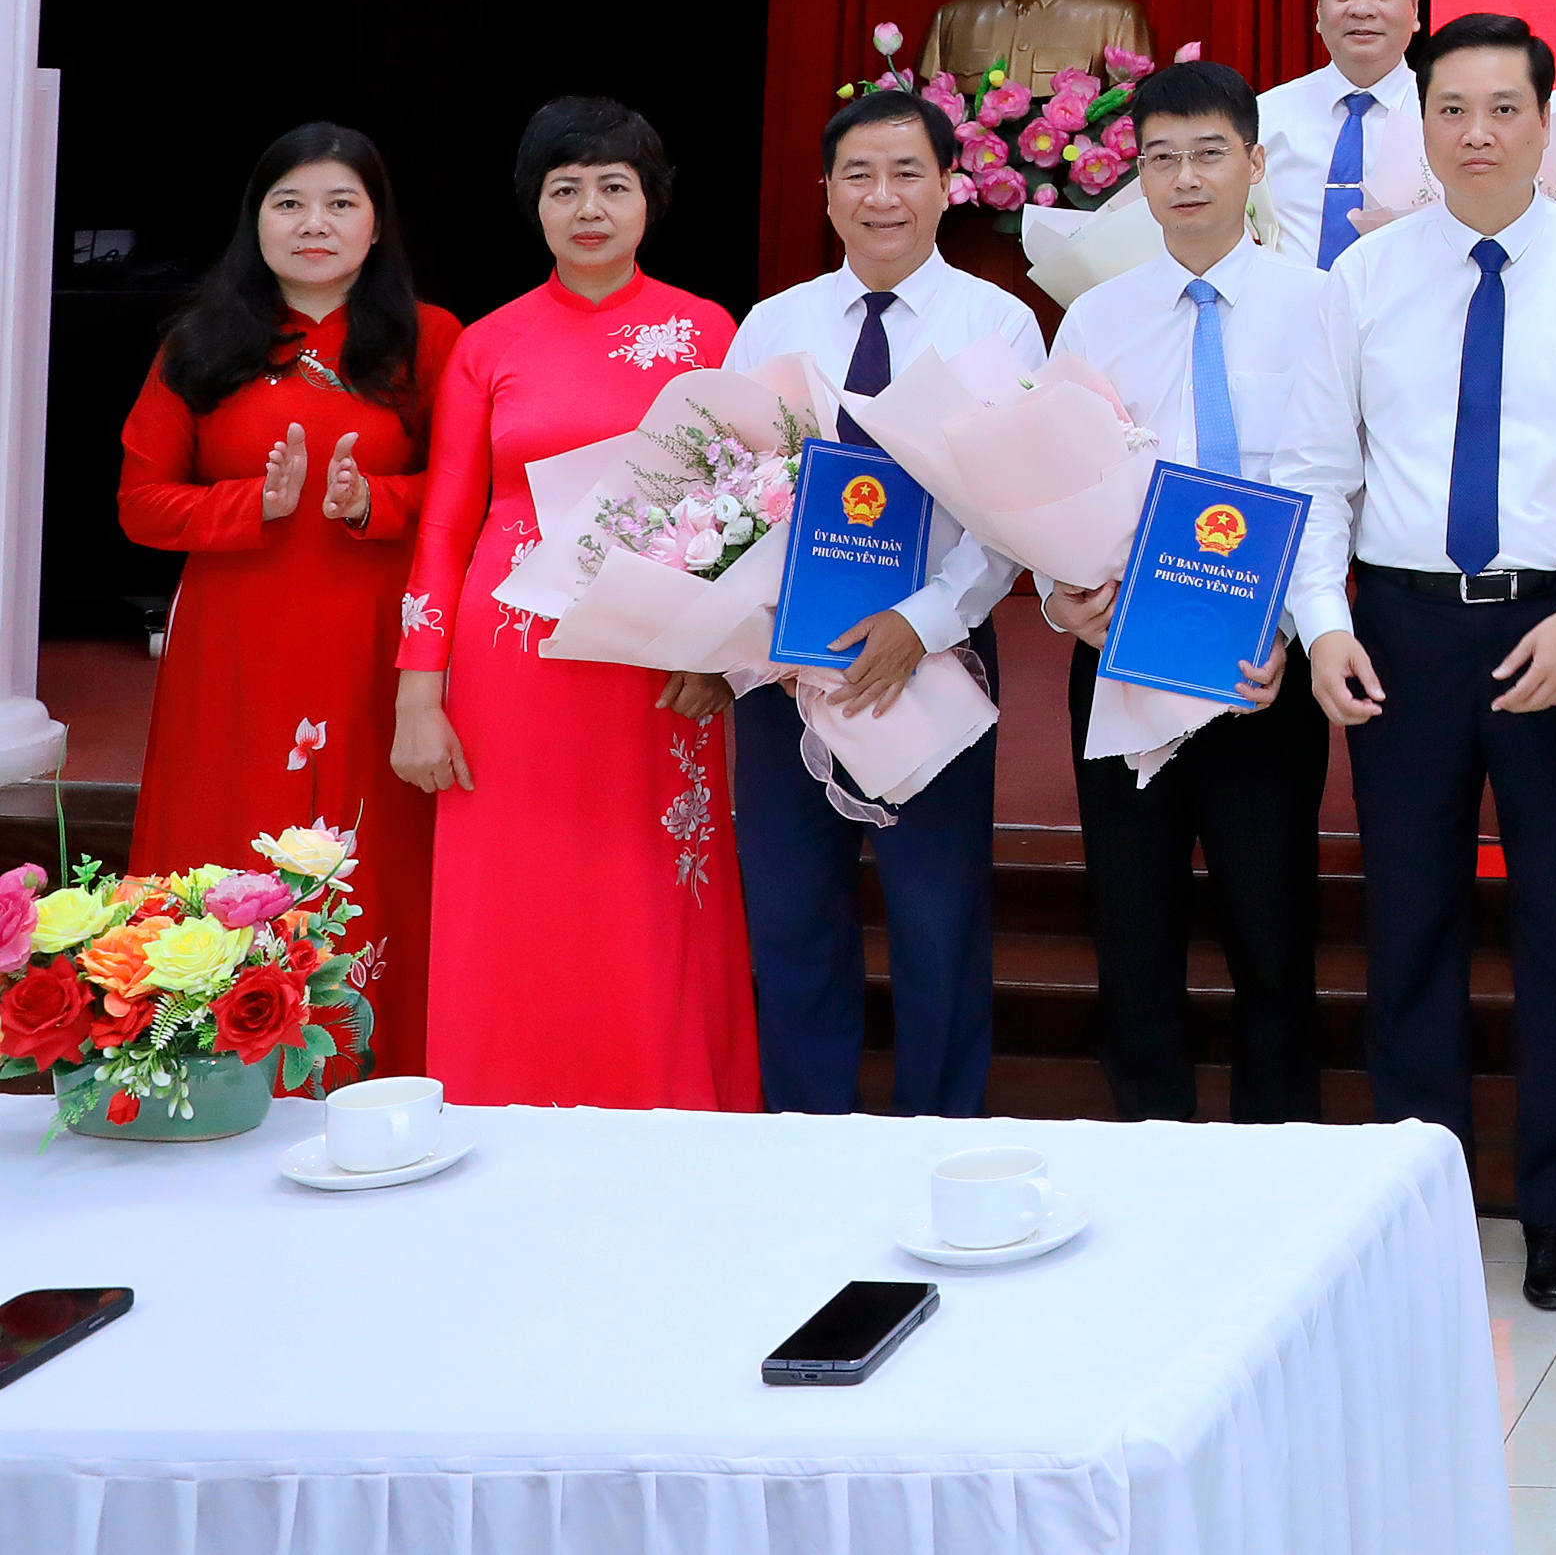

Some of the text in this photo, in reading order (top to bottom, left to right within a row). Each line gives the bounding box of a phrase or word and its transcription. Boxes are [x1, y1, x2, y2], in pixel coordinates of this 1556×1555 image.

[814, 528, 902, 551] ỦY BAN NHÂN DÂN
[812, 546, 900, 567] PHƯỜNG YÊN HOÀ
[1159, 552, 1260, 584] ỦY BAN NHÂN DÂN
[1154, 569, 1254, 599] PHƯỜNG YÊN HOÀ
